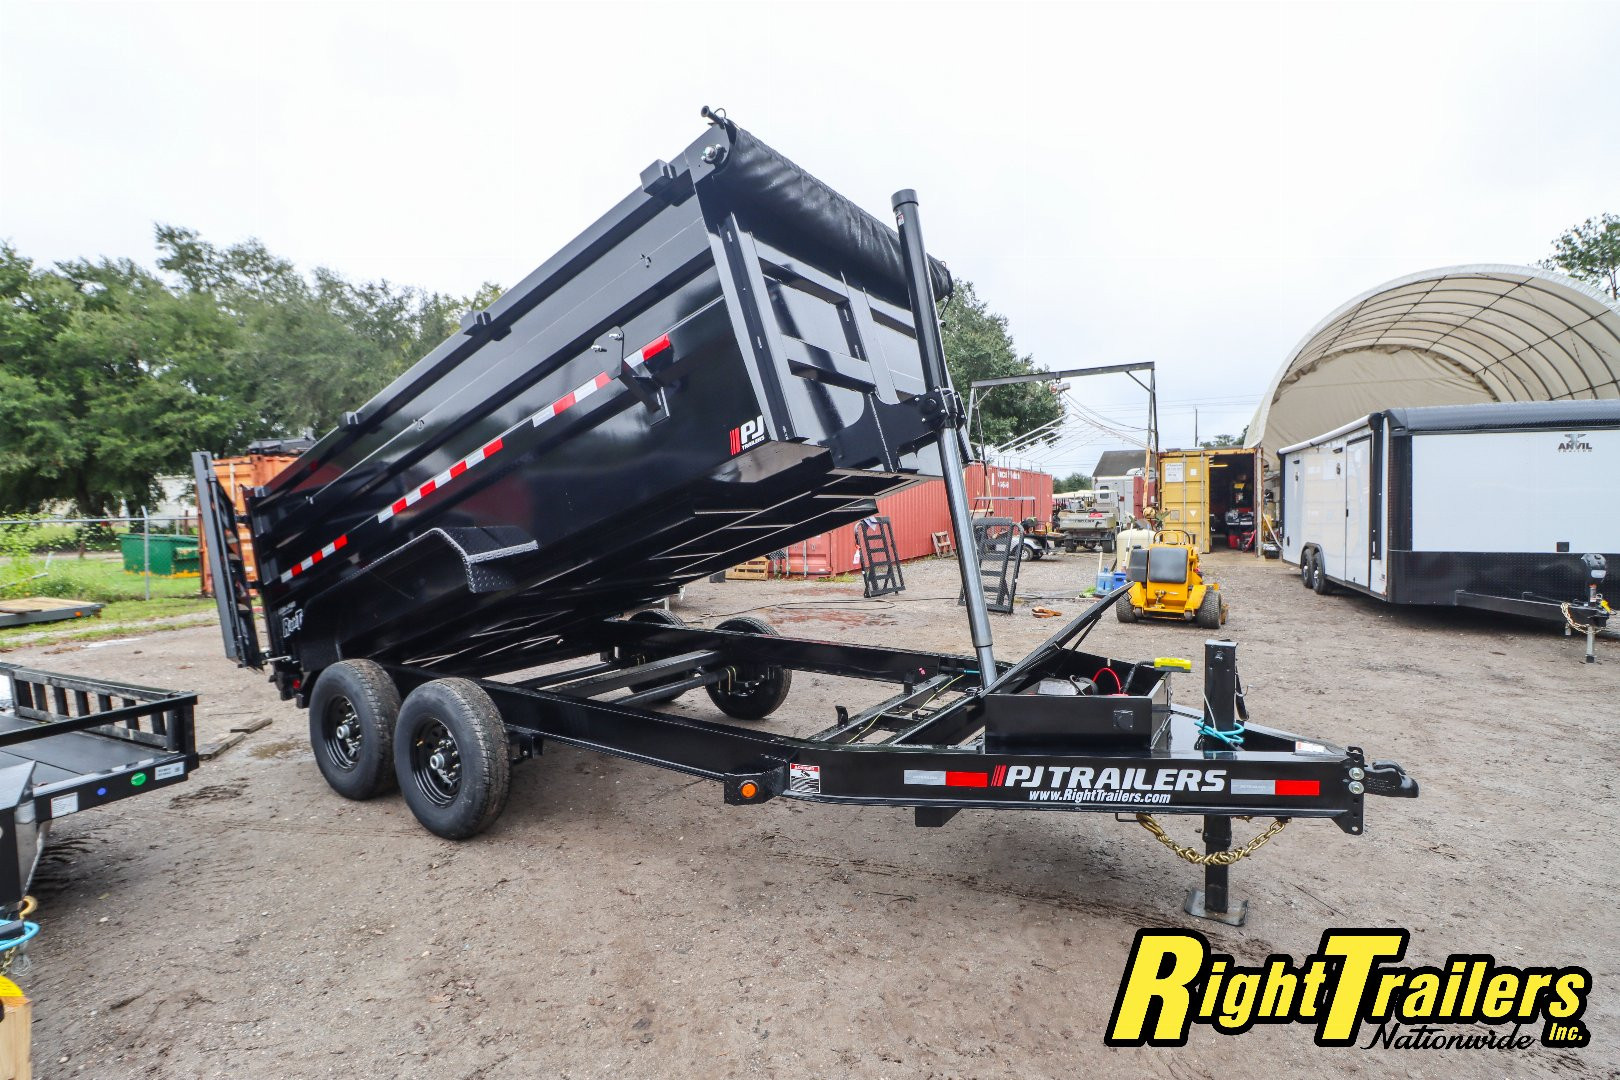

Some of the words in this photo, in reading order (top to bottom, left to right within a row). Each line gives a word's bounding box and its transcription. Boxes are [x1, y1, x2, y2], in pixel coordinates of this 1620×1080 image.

[741, 415, 765, 445] PJ
[1558, 442, 1592, 450] ANVIL
[1004, 765, 1045, 788] PJ
[1048, 766, 1227, 792] TRAILERS
[1029, 788, 1171, 804] www.RightTrailers.com
